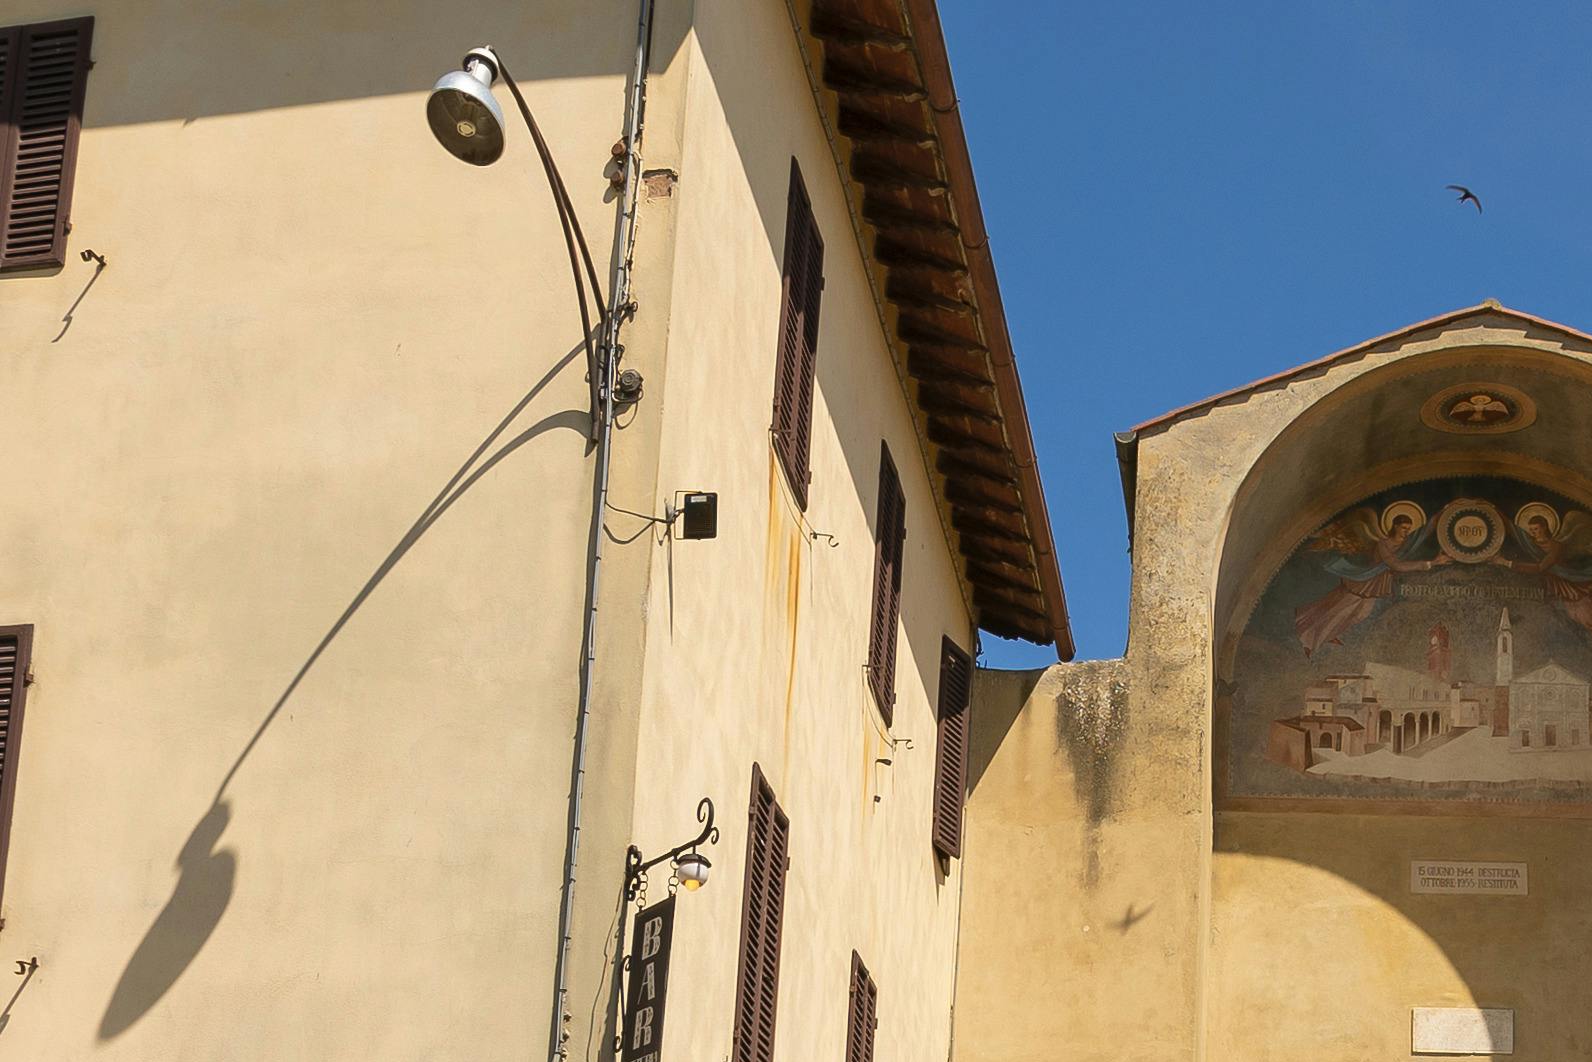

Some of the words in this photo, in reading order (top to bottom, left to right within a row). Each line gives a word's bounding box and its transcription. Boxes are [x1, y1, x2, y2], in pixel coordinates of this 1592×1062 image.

[1427, 867, 1455, 876] GIUGNO
[1456, 867, 1473, 877] 1944
[1420, 877, 1455, 887] OTTOBRE
[1478, 878, 1518, 889] RESTITUTA
[632, 916, 662, 1051] BAR
